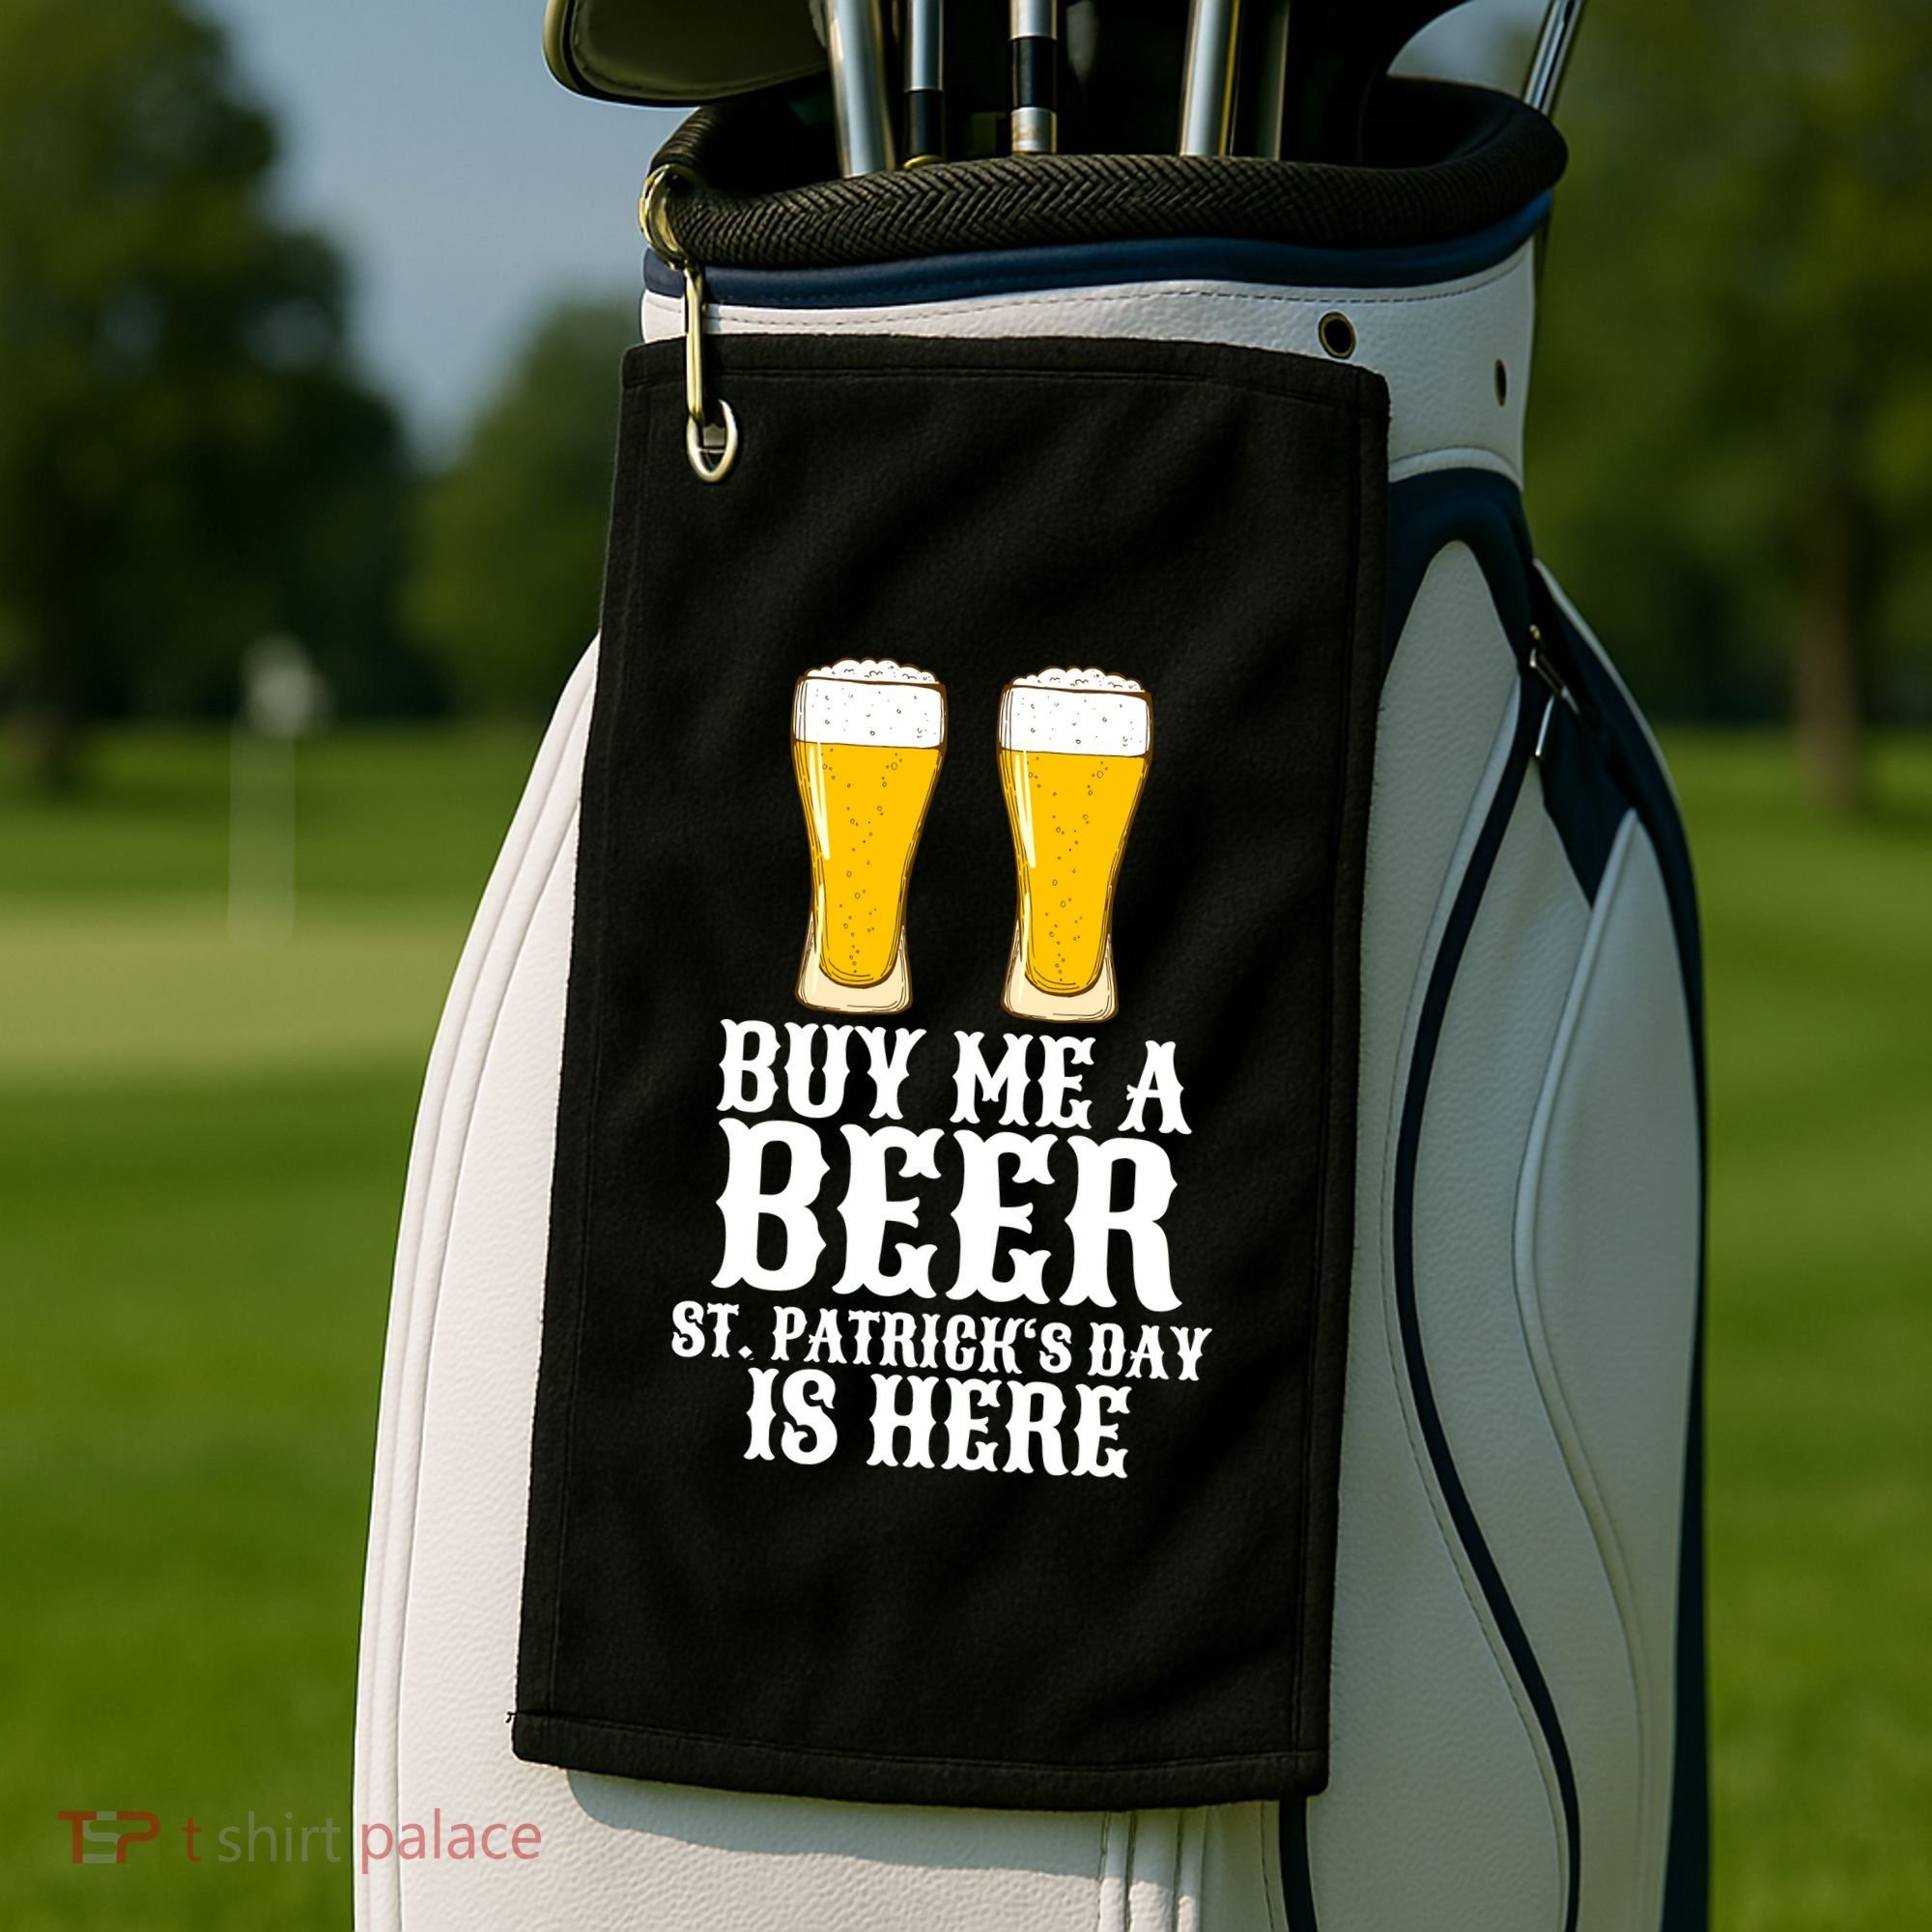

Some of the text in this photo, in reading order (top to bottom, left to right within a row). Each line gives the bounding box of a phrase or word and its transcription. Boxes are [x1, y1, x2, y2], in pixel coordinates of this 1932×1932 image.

[716, 1018, 1192, 1135] BUY ME A
[710, 1117, 1182, 1312] BEER
[671, 1300, 753, 1359] ST.
[1088, 1321, 1213, 1381] DAY
[743, 1367, 1132, 1479] IS HERE
